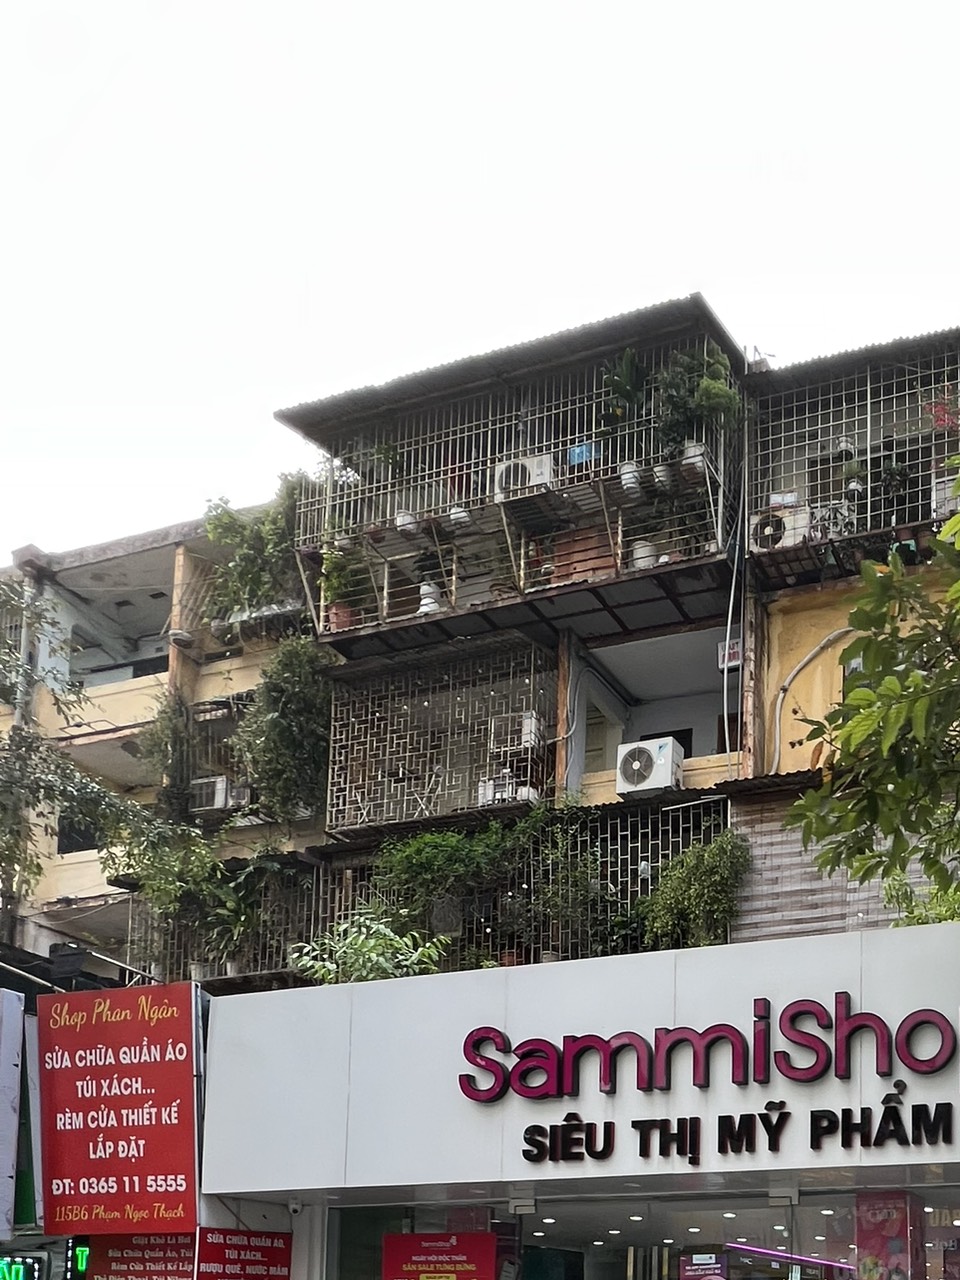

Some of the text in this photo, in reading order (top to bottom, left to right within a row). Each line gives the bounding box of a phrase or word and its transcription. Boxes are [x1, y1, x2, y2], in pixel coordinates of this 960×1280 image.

[50, 994, 179, 1032] Shop Phan Ngân
[45, 1036, 187, 1070] SỬA CHỮA QUẦN ÁO
[76, 1073, 155, 1098] TÚI XÁCH...
[56, 1098, 181, 1131] RÈM CỬA THIẾT KẾ
[521, 1079, 954, 1166] SIÊU THỊ MỸ PHẨM
[89, 1133, 145, 1163] LẮP ĐẶT
[52, 1174, 186, 1196] ĐT: 0365 11 5555
[55, 1203, 184, 1223] 115B6 Phạm Ngọc Thạch
